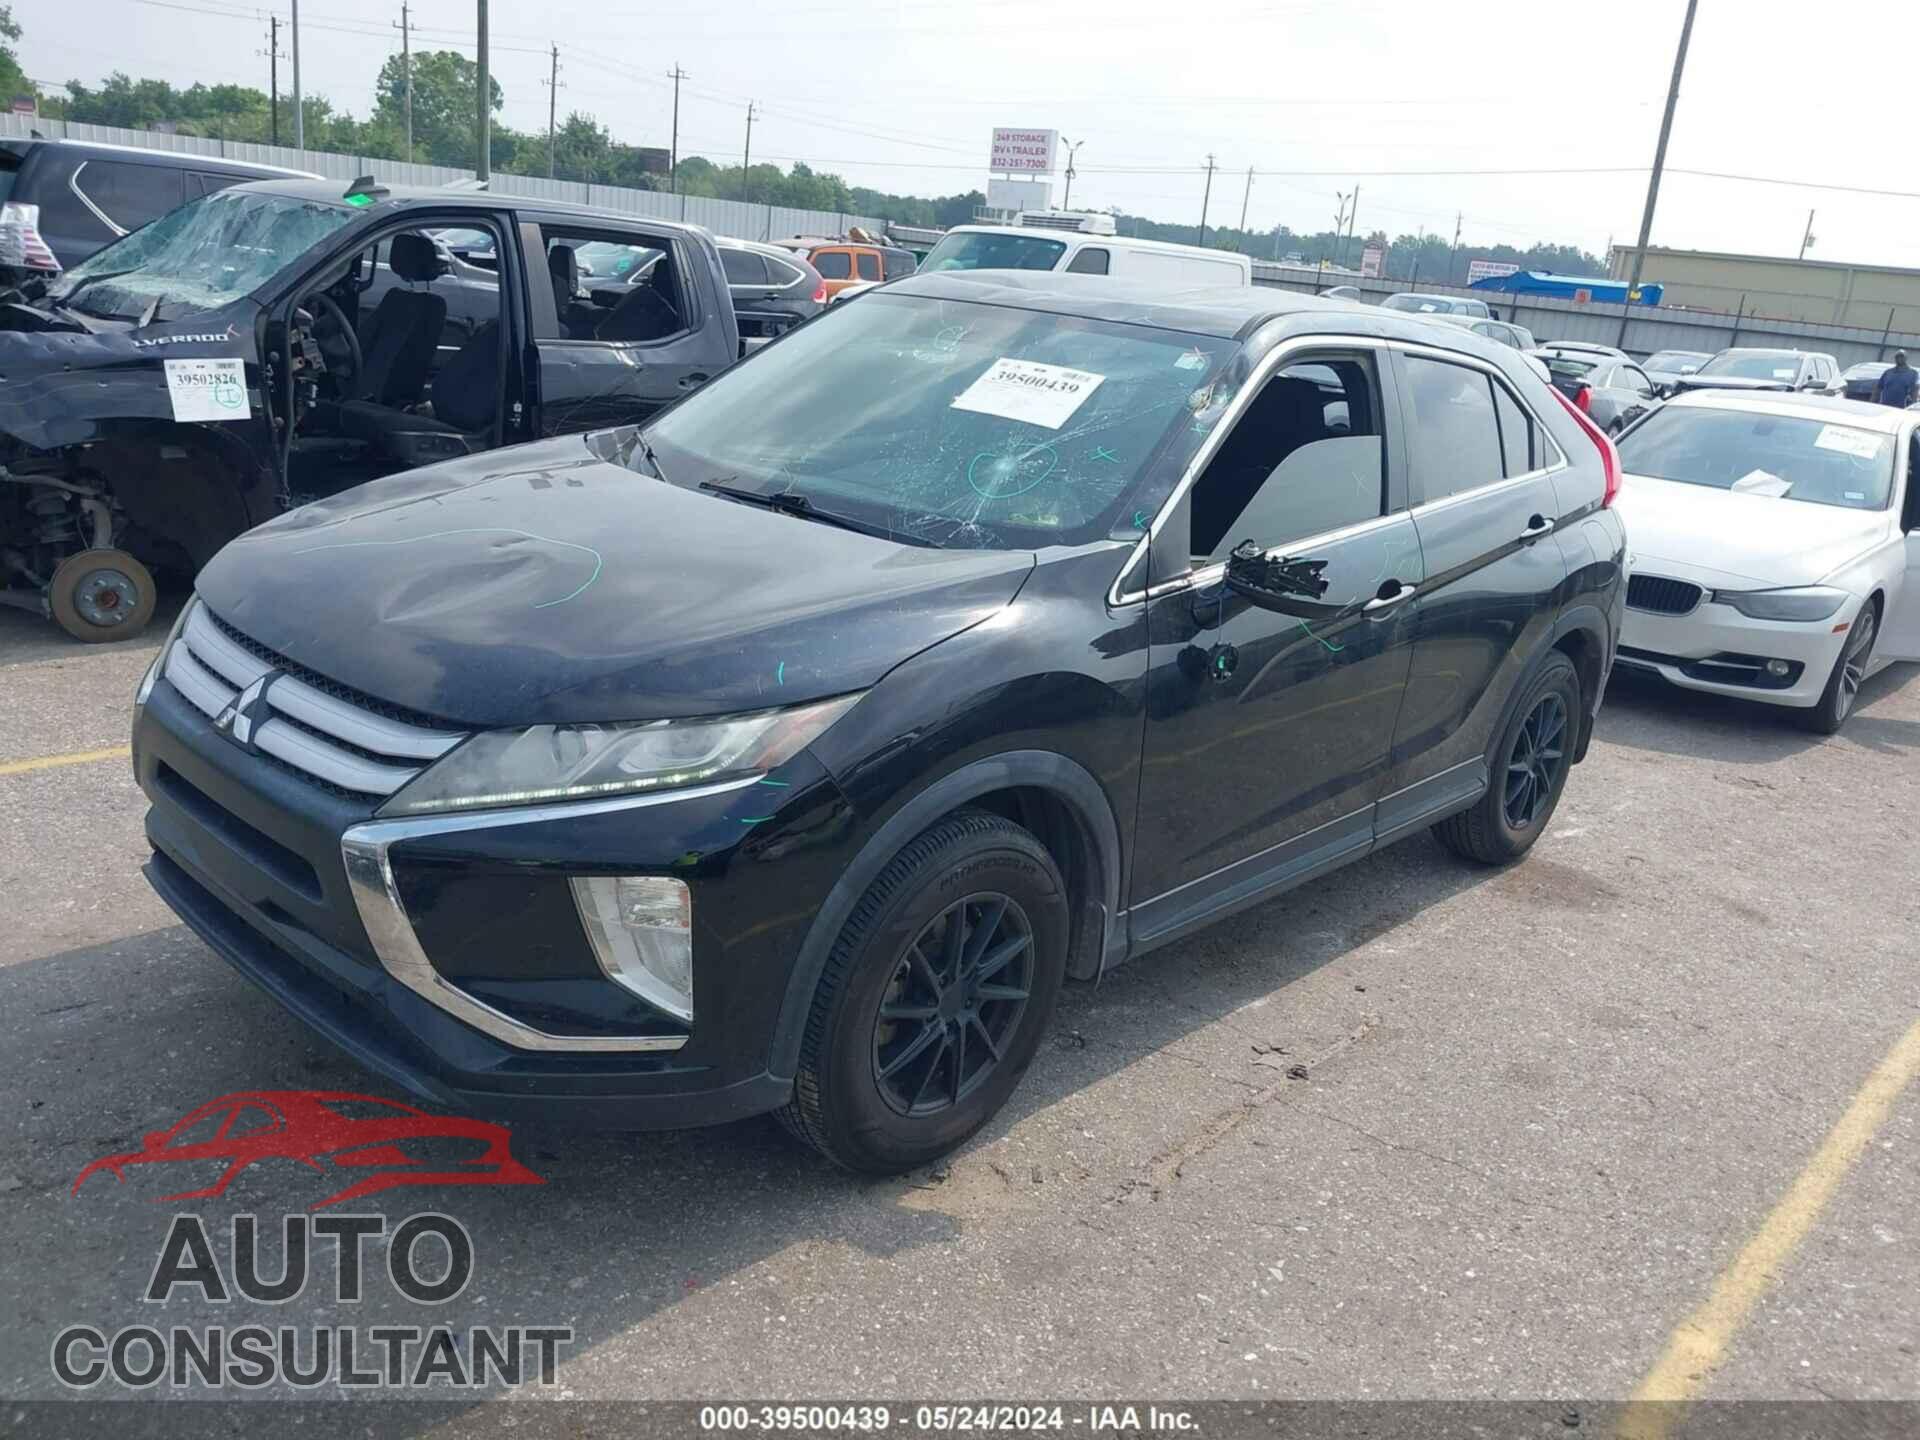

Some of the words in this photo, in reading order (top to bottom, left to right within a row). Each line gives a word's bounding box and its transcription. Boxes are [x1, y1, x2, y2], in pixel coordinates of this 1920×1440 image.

[1012, 146, 1047, 155] TRAILER
[133, 333, 229, 348] LVERADO
[176, 373, 238, 386] 39502826
[992, 370, 1080, 393] 39500439
